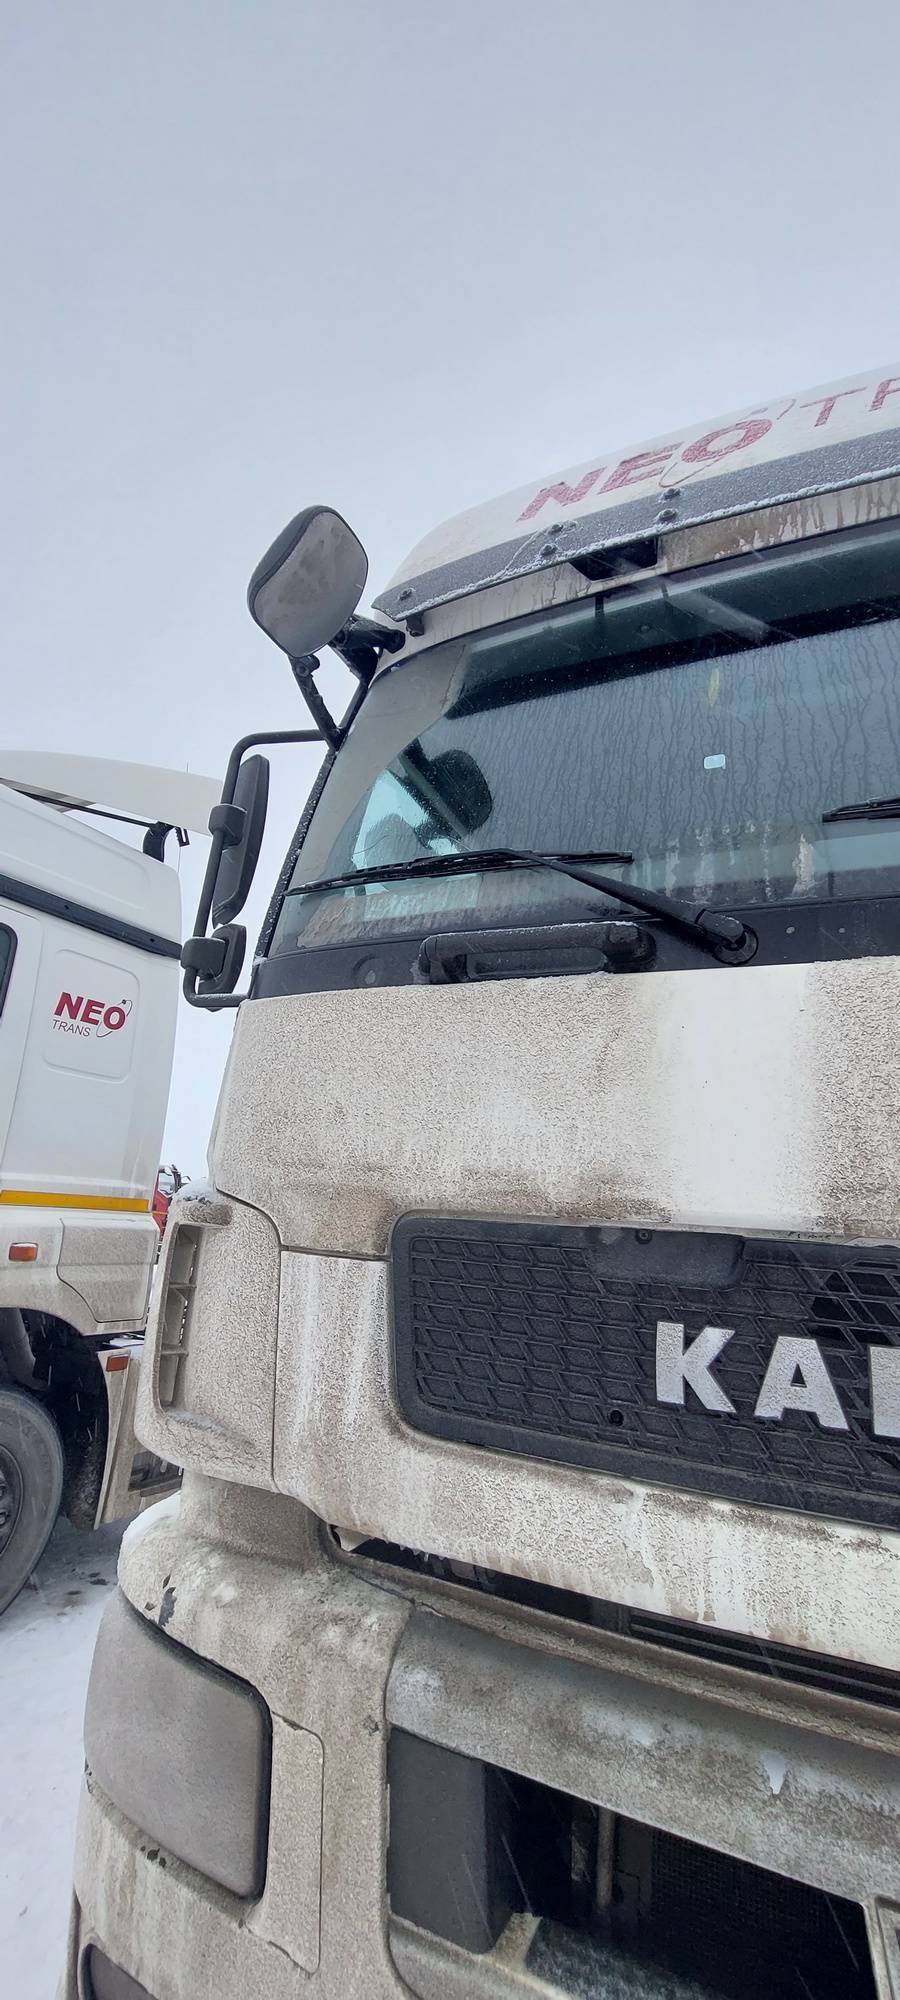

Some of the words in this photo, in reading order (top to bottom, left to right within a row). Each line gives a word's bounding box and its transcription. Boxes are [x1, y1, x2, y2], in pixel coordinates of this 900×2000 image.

[515, 418, 773, 523] NEO
[52, 1019, 91, 1037] TRANS
[53, 991, 126, 1030] NEO
[655, 1320, 900, 1439] KA
